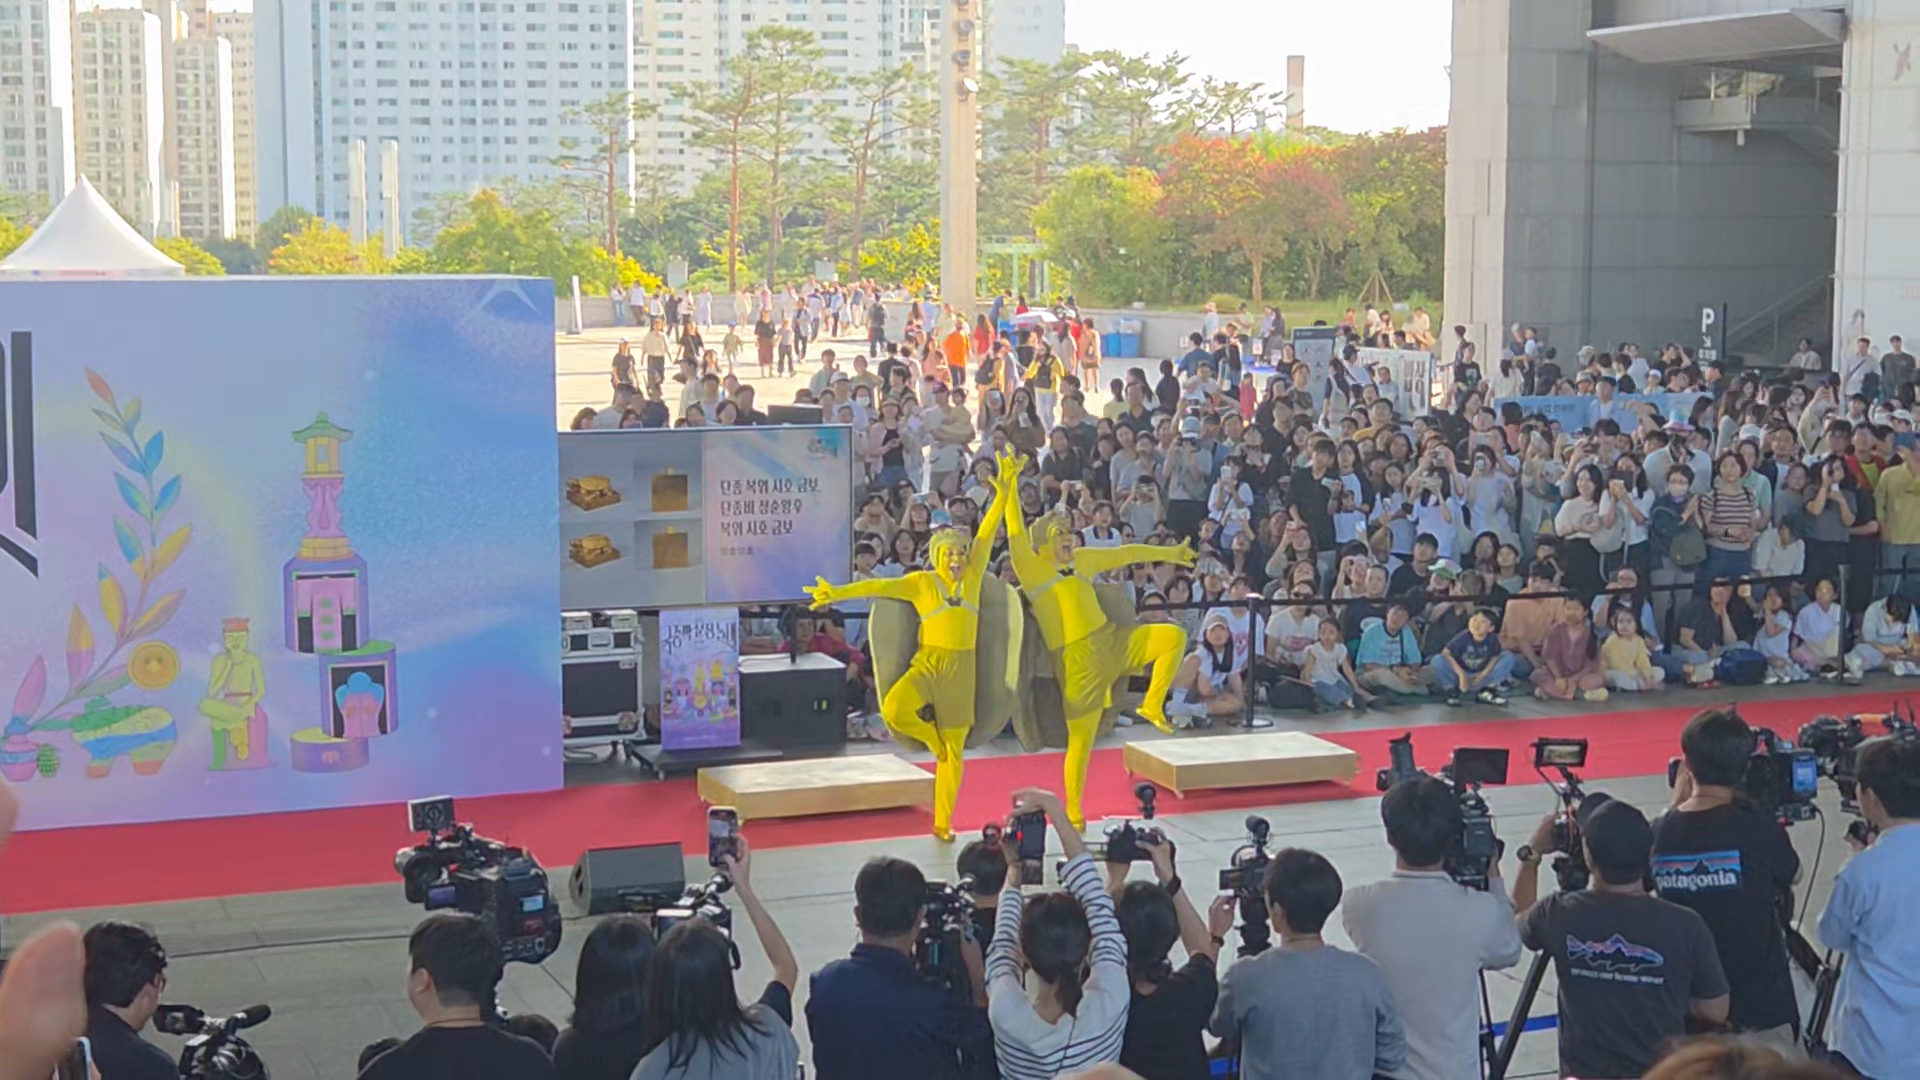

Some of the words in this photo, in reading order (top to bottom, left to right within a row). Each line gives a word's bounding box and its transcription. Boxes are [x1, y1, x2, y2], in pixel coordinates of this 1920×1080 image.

[1701, 307, 1715, 333] P
[720, 479, 742, 496] 단종
[772, 478, 793, 494] 시호
[797, 477, 821, 493] 금보
[720, 499, 755, 517] 단종비
[746, 519, 768, 536] 시호
[771, 519, 793, 536] 금보
[1656, 870, 1737, 892] patagonia
